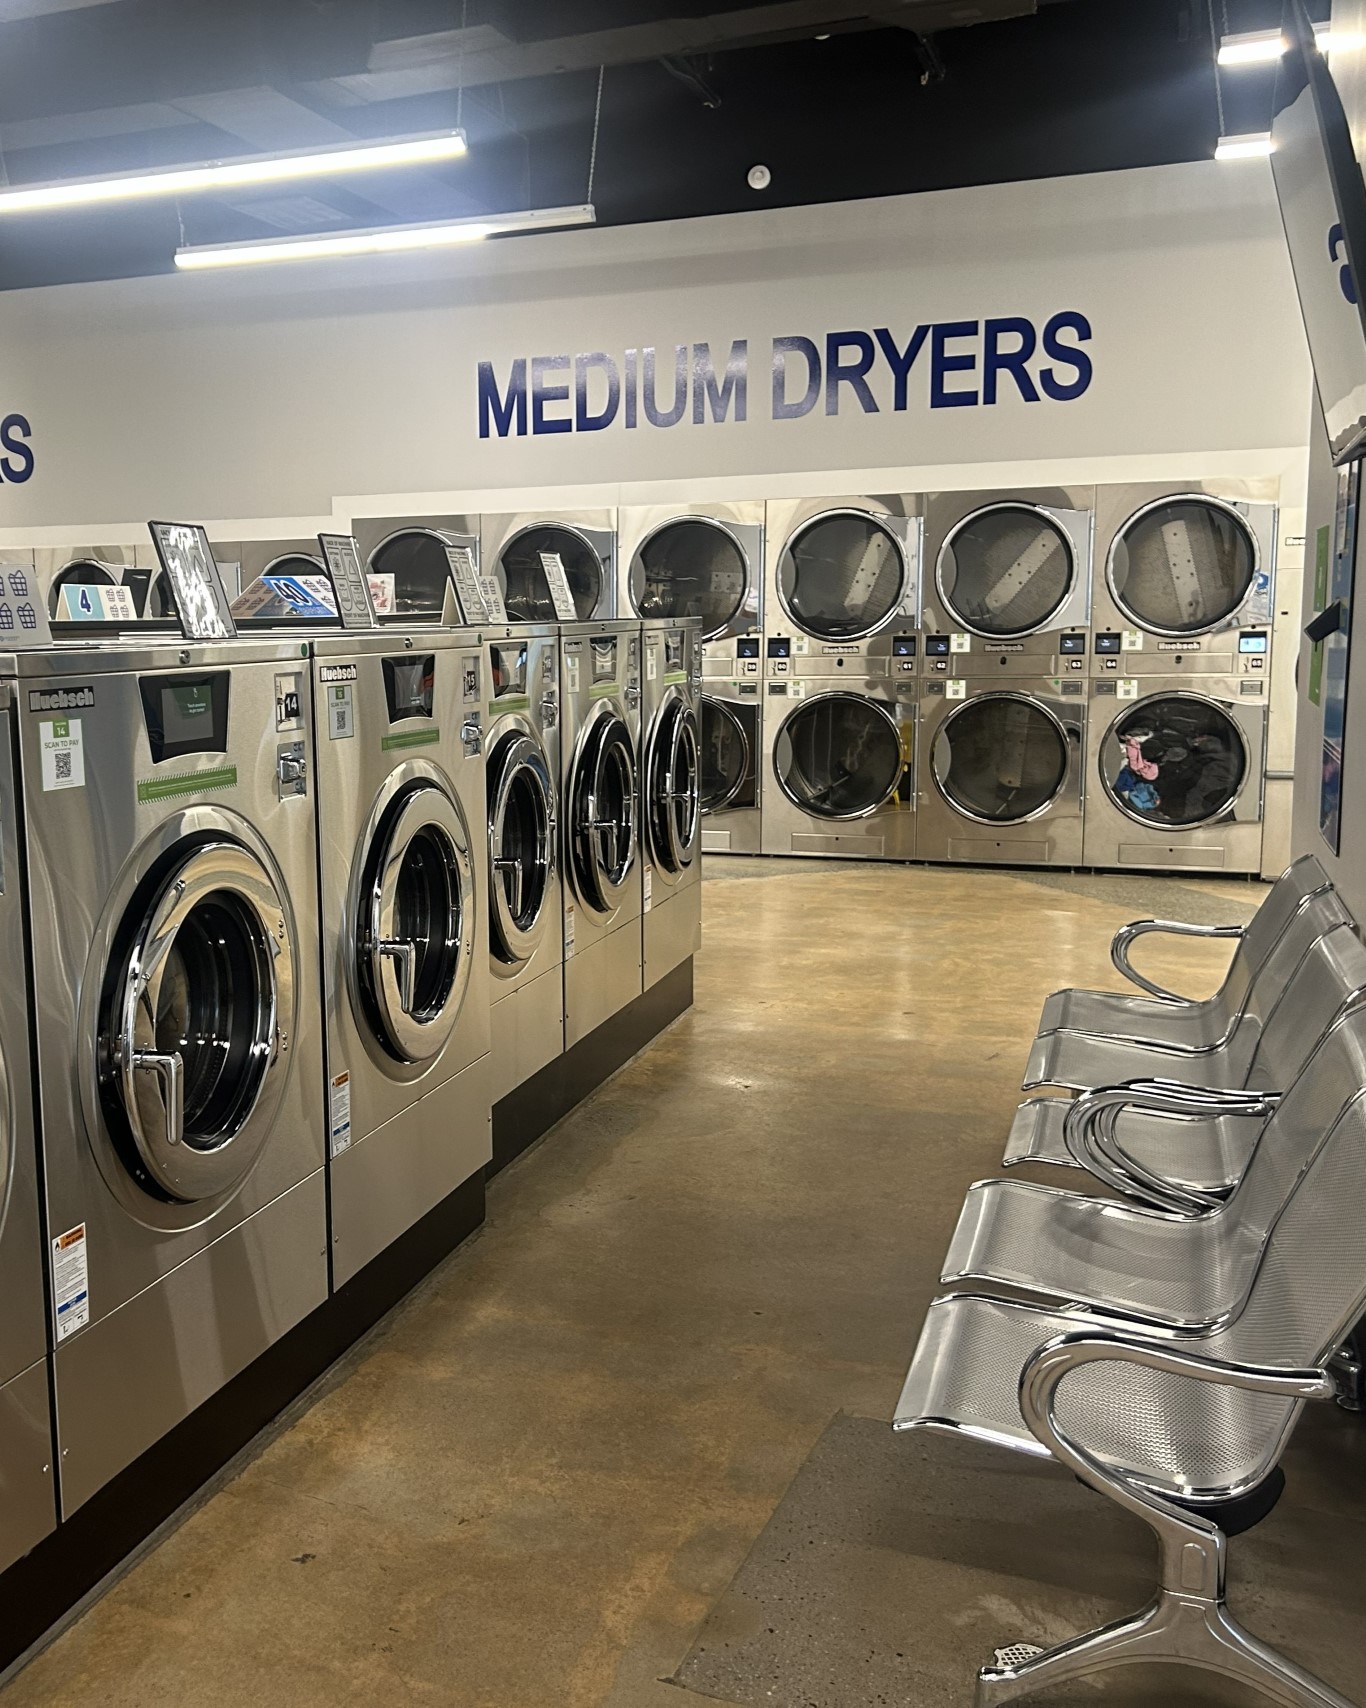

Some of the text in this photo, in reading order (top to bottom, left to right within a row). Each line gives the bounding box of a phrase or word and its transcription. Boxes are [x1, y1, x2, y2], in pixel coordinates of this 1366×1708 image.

[477, 310, 1093, 439] MEDIUM DRYERS
[0, 413, 35, 484] S
[80, 588, 92, 613] 4
[321, 665, 357, 681] Huebsch
[29, 688, 94, 710] Huebsch
[286, 696, 298, 711] 14
[57, 727, 66, 736] 14
[44, 741, 60, 749] SCAN
